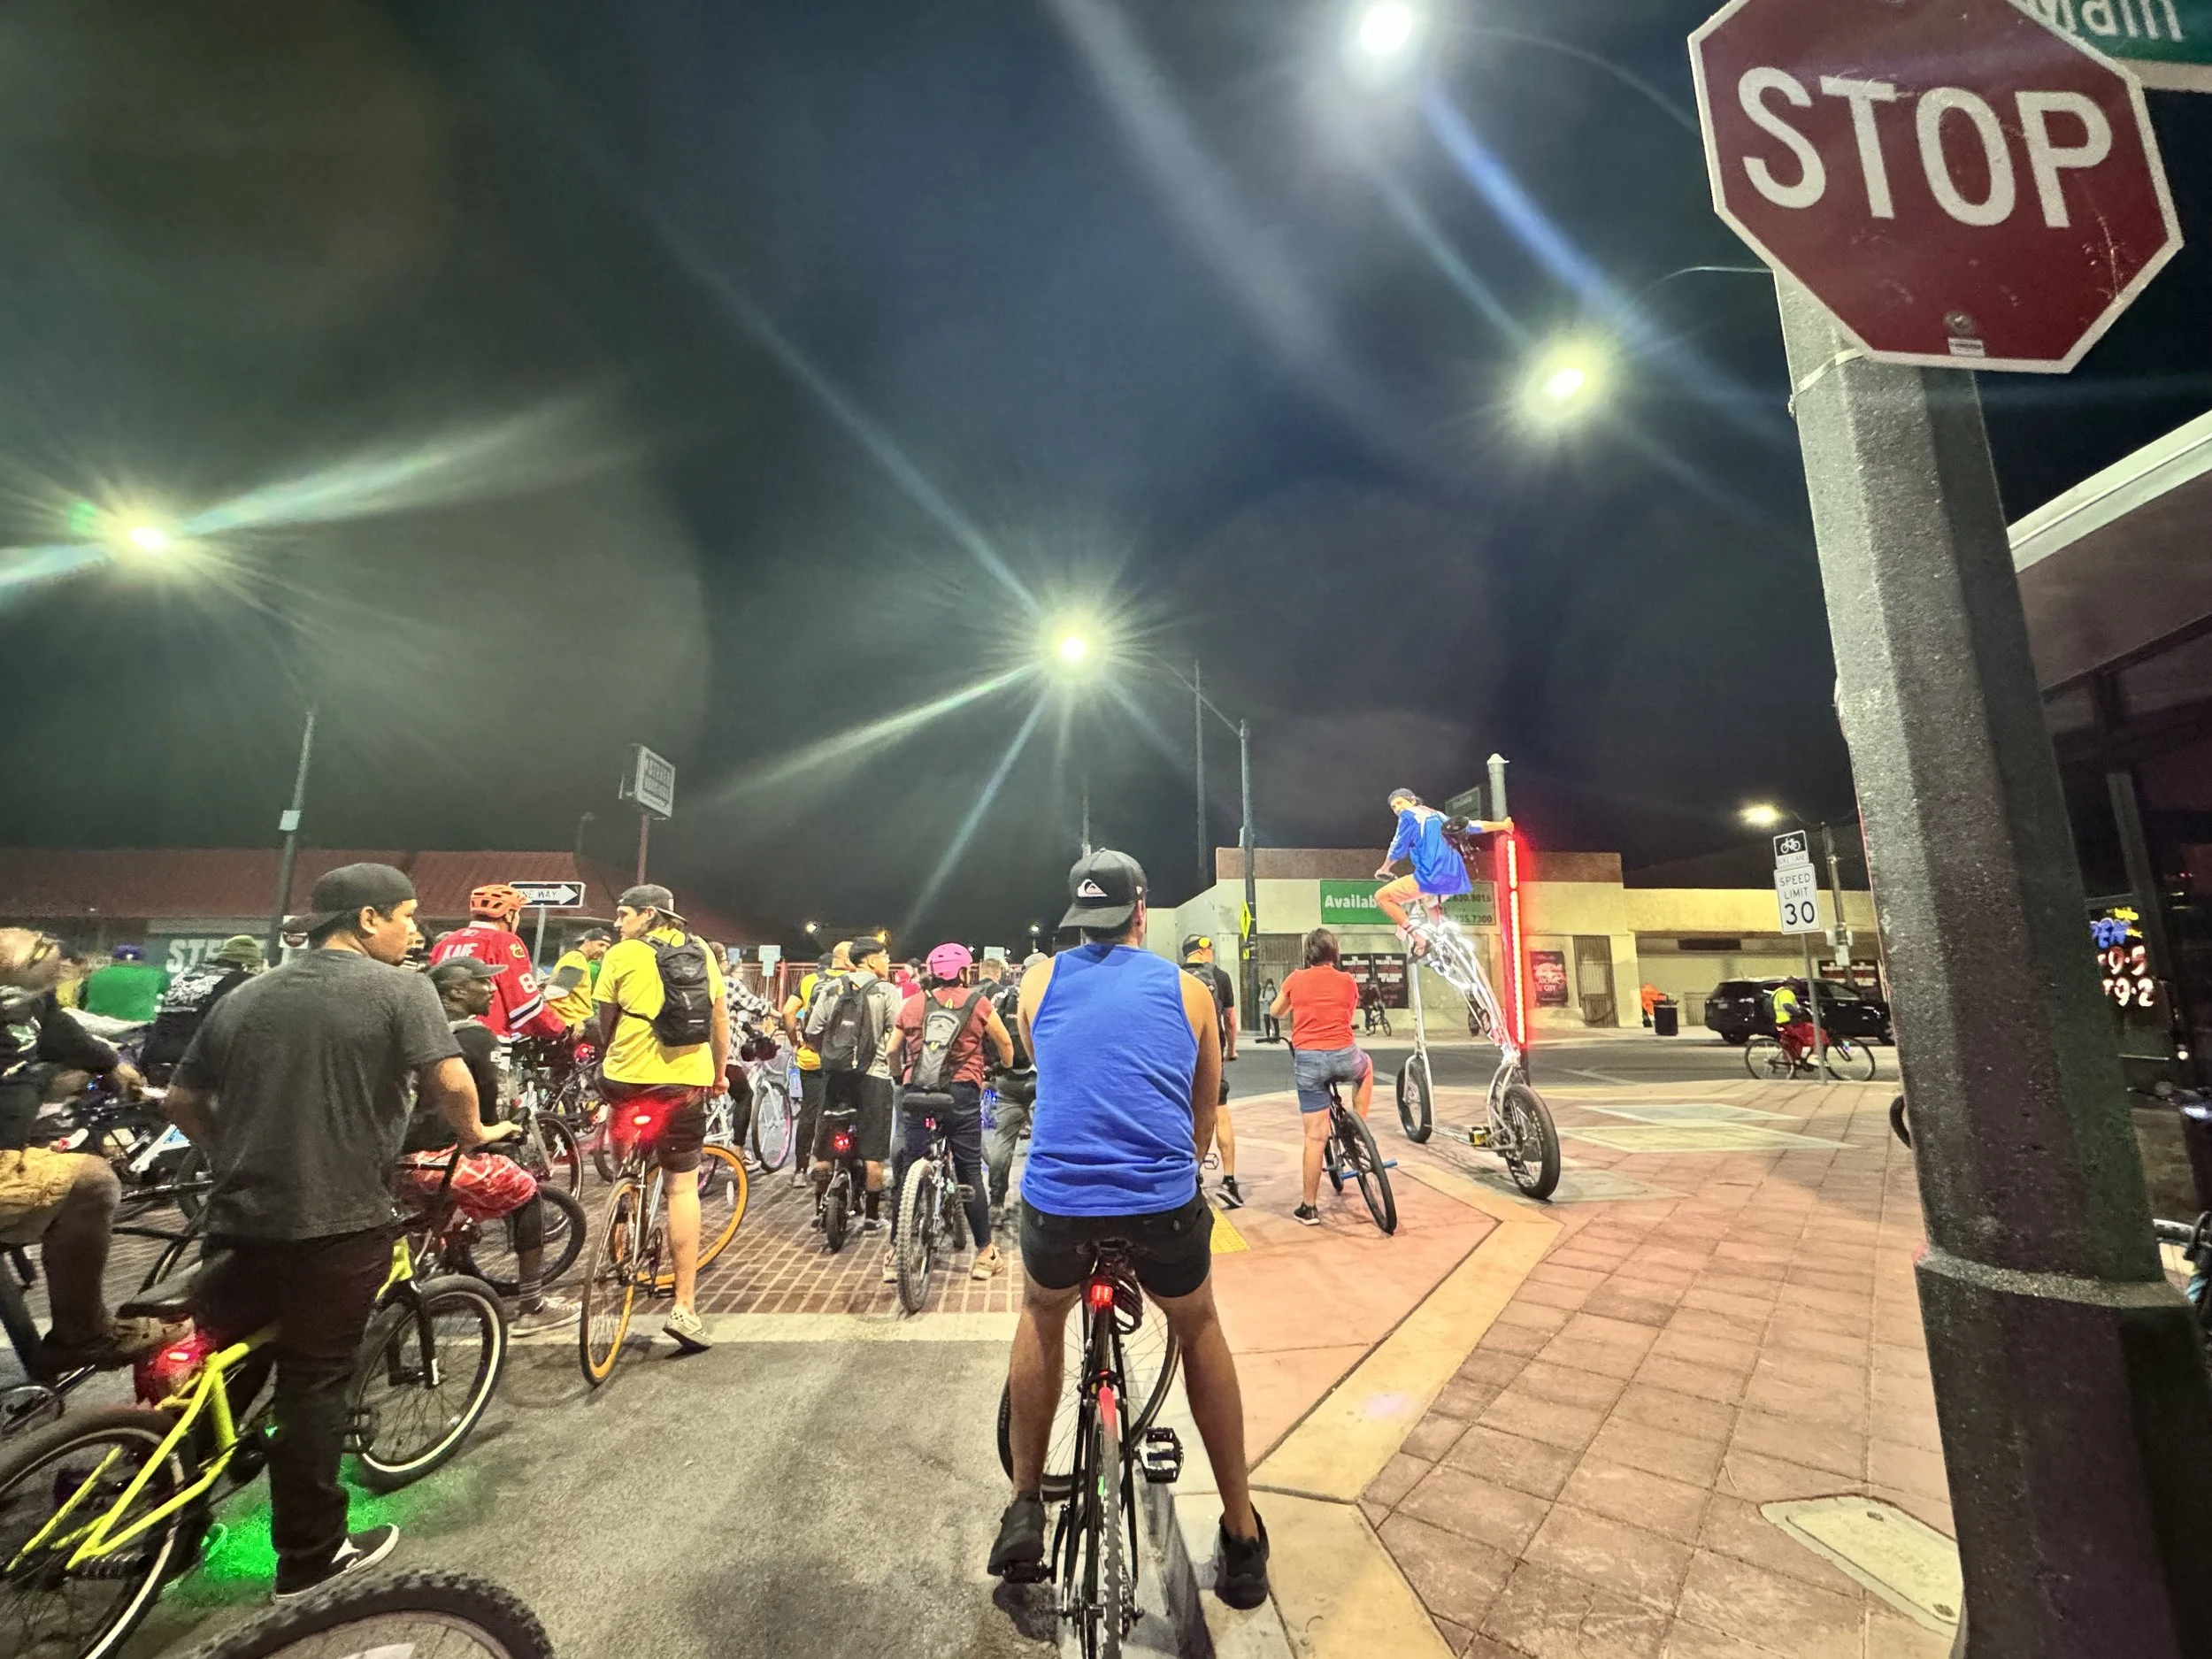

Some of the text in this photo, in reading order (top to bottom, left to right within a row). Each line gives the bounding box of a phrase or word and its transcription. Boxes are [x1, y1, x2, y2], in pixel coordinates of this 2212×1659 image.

[1738, 66, 2113, 228] STOP
[1779, 872, 1810, 887] SPEED
[538, 890, 557, 899] WAY
[1784, 887, 1808, 899] LIMIT
[1325, 894, 1378, 909] Availab
[1785, 901, 1815, 926] 30
